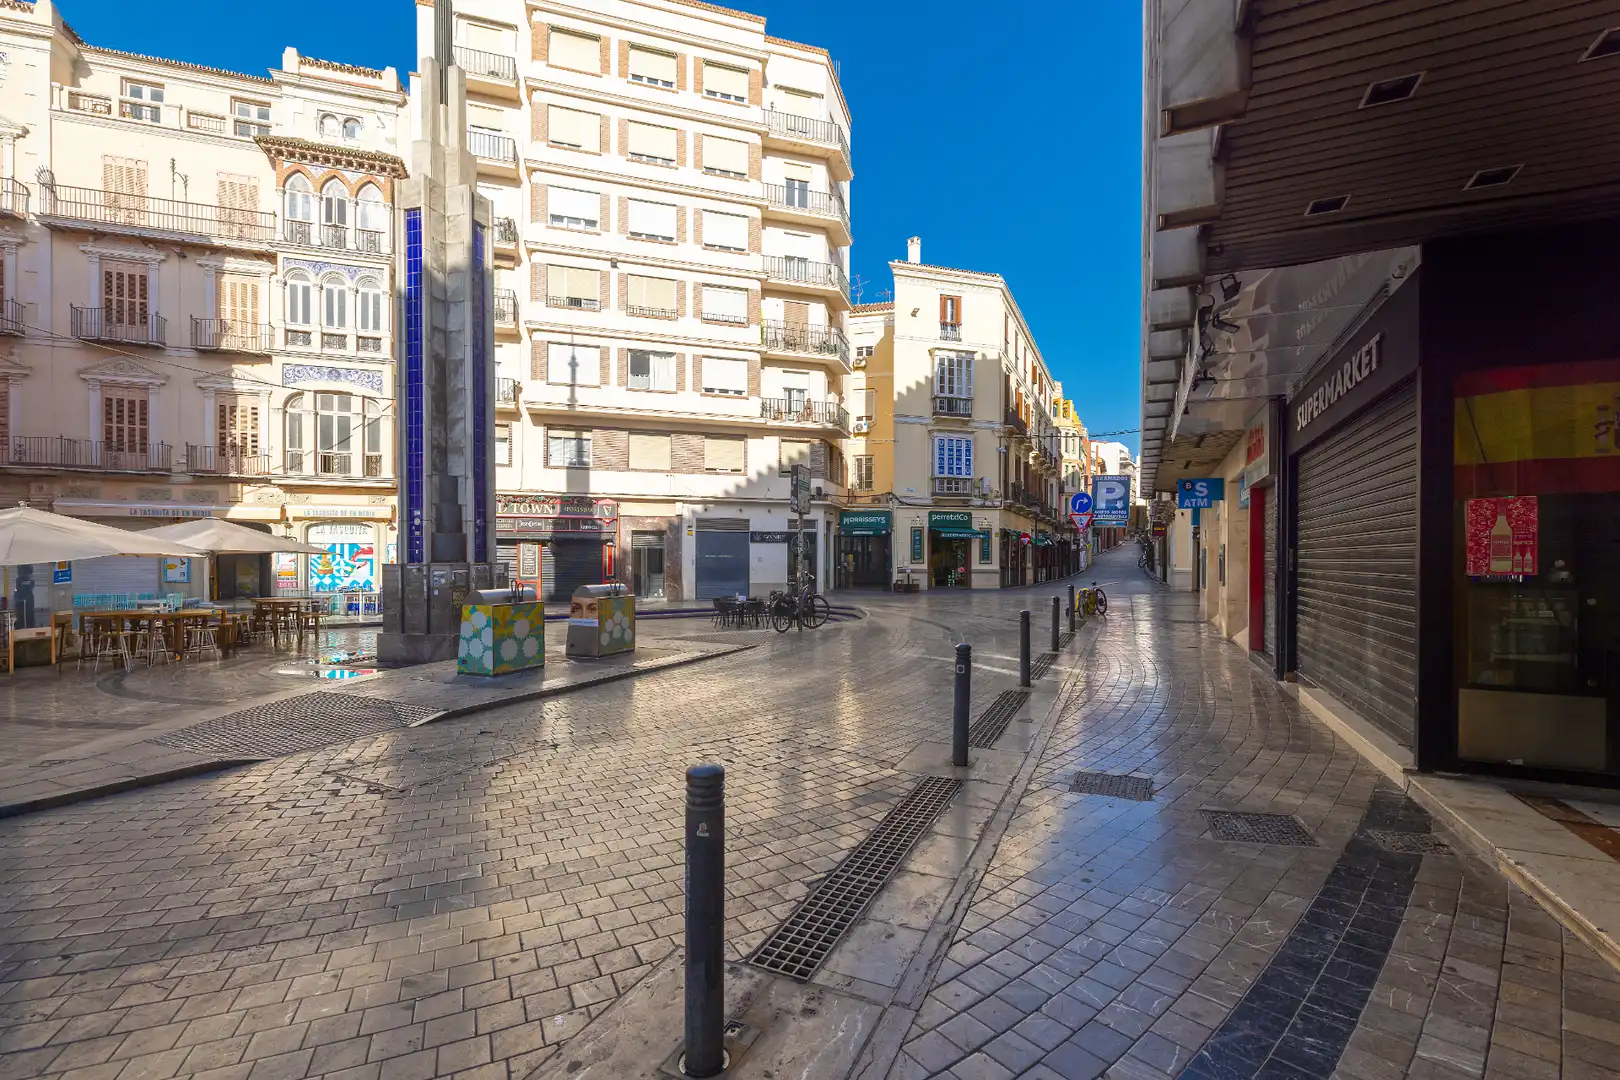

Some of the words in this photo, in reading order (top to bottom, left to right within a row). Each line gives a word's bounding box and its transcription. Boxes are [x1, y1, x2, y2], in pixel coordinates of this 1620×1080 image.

[1297, 332, 1380, 432] SUPERMARKET
[1097, 481, 1125, 509] P
[1184, 498, 1208, 507] ATM
[511, 503, 553, 514] TOWN
